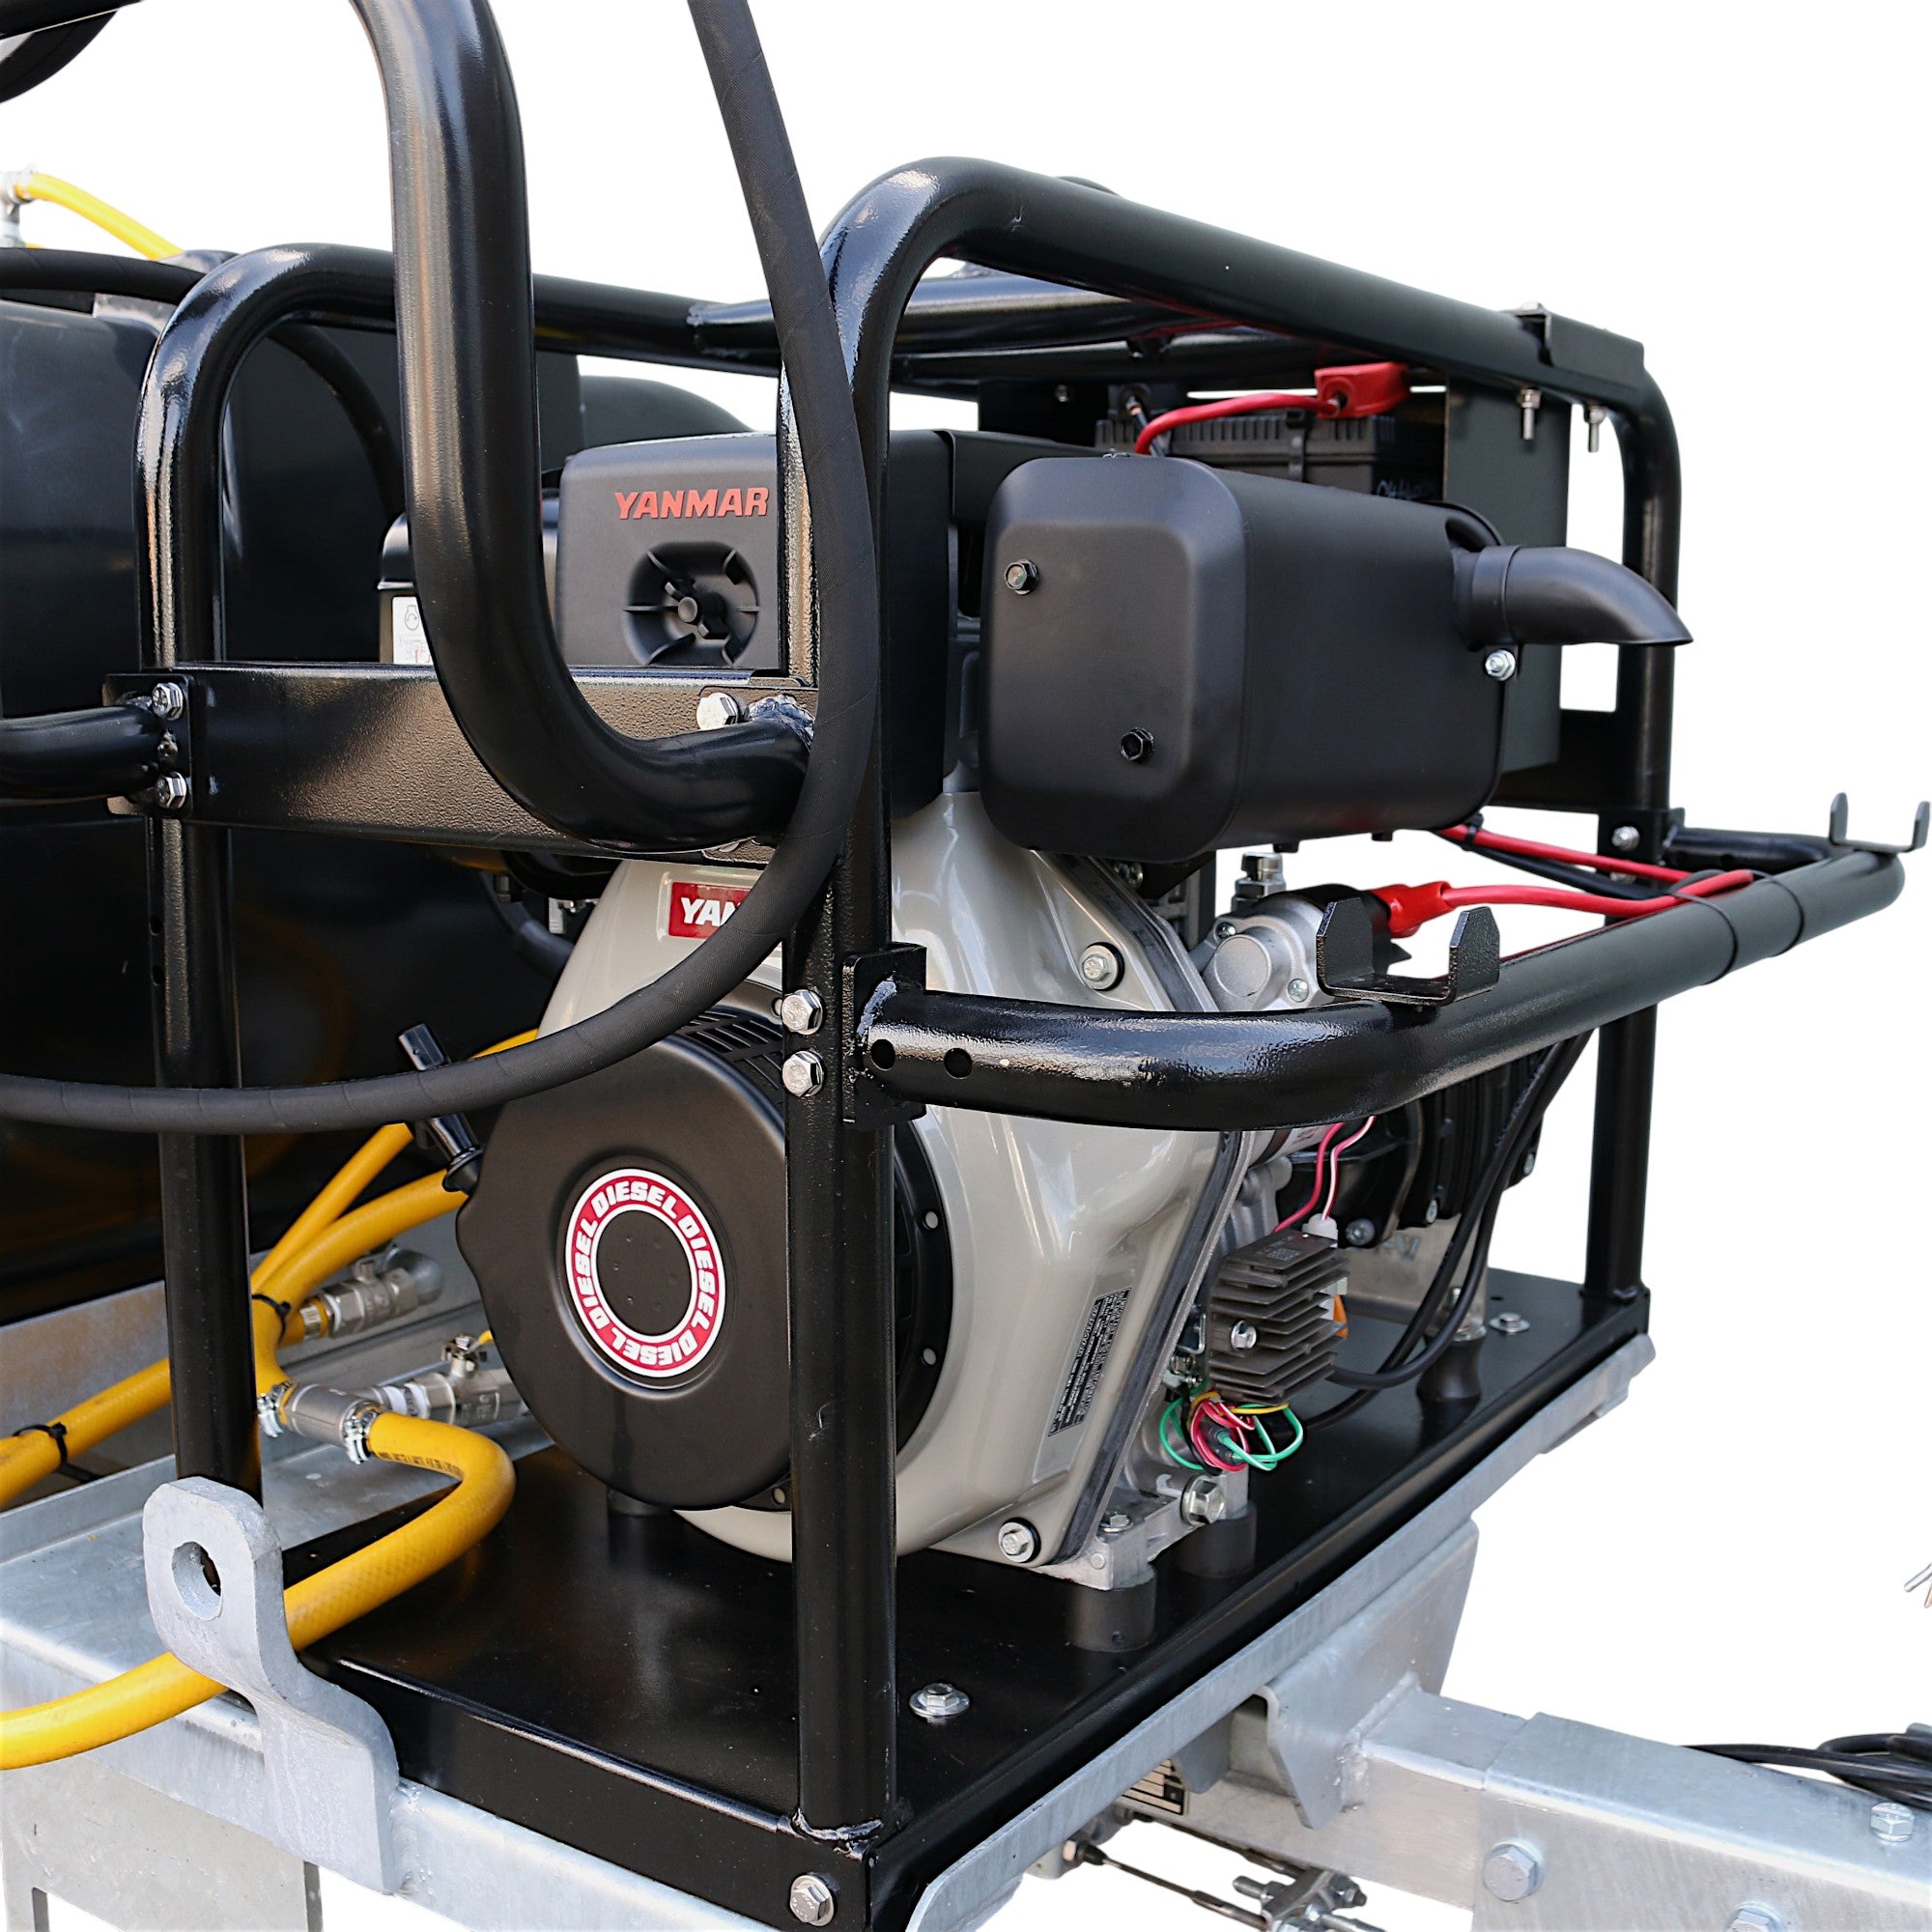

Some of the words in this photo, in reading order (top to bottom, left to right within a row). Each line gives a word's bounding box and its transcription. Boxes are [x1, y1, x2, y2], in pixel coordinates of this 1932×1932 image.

[614, 487, 769, 520] YANMAR
[590, 1180, 678, 1219] DIESEL
[575, 1217, 611, 1330] DIESEL
[677, 1214, 716, 1331] DIESEL
[611, 1326, 698, 1366] DIESEL
